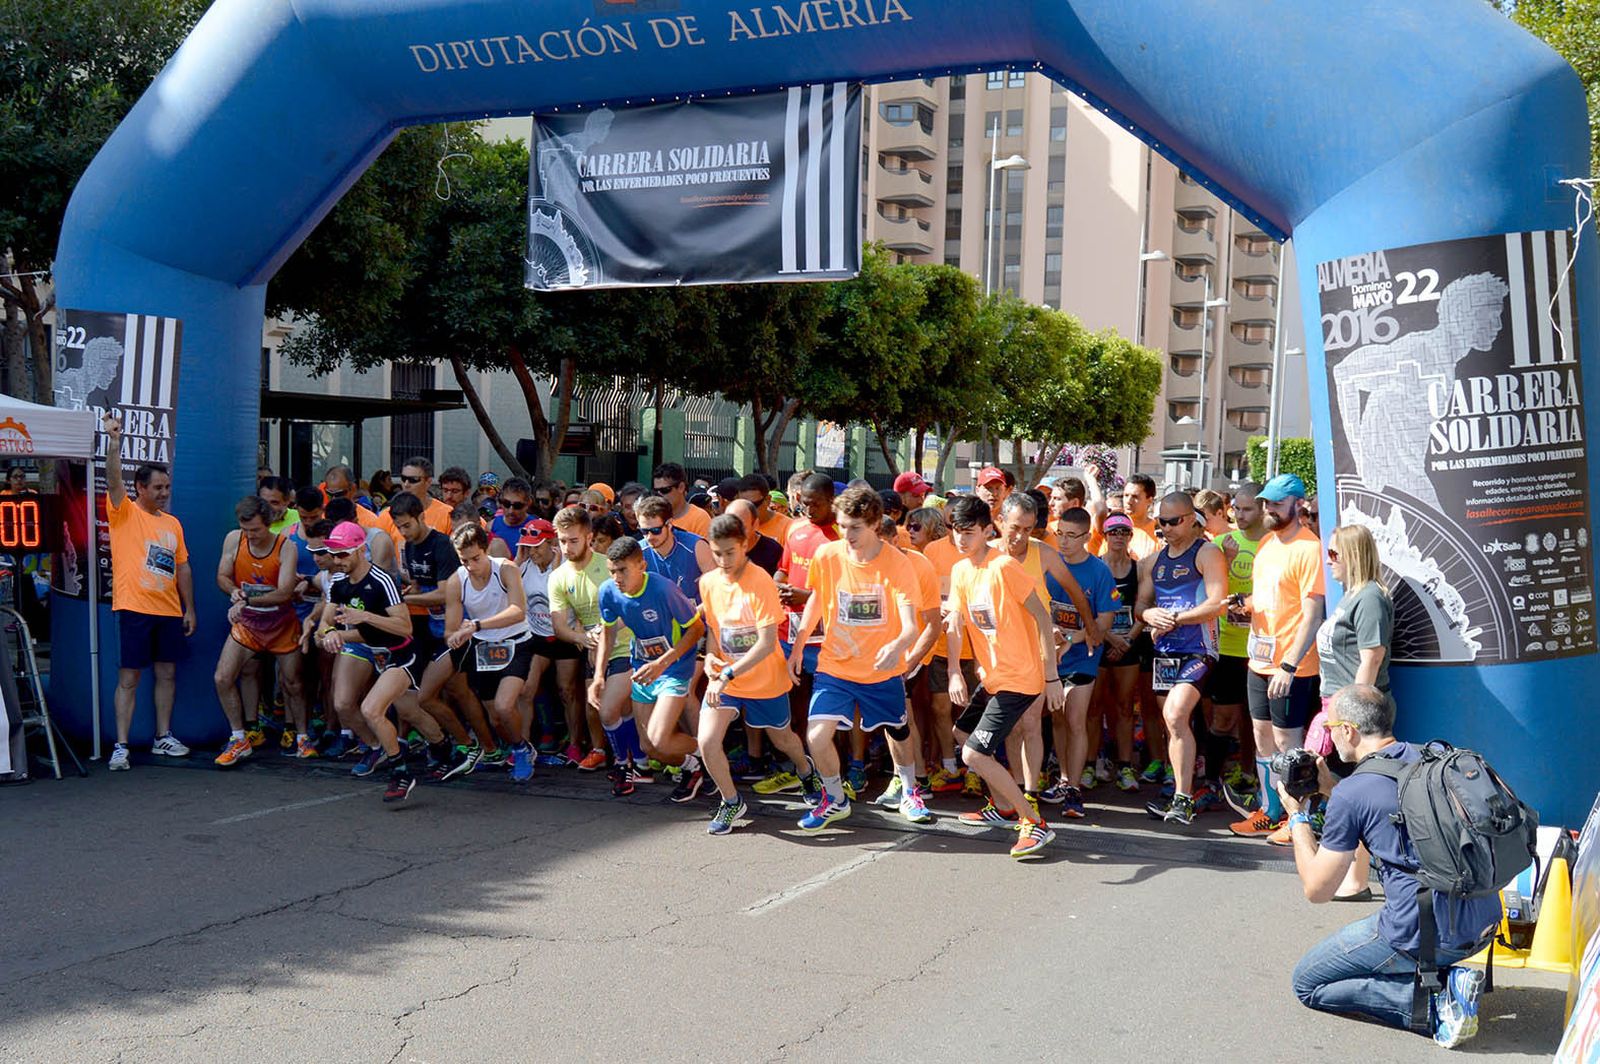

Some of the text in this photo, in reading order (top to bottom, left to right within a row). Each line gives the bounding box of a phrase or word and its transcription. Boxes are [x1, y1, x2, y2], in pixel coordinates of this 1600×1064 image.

[409, 18, 638, 73] DIPUTACIÓN
[648, 15, 706, 50] DE
[576, 140, 771, 178] CARRERA SOLIDARIA
[595, 178, 612, 191] LAS
[614, 173, 683, 190] ENFERMEDADES
[685, 171, 708, 185] POCO
[709, 168, 771, 184] FRECUENTES
[1351, 280, 1393, 295] Domingo
[1352, 268, 1442, 310] MAYO 22
[66, 326, 86, 350] 22
[1321, 302, 1400, 351] 2016
[1428, 369, 1581, 419] CARRERA
[1430, 409, 1583, 455] SOLIDARIA
[1431, 460, 1450, 471] POR
[1450, 458, 1465, 470] LAS
[1466, 453, 1527, 469] ENFERMEDADES
[1528, 451, 1546, 463] POCO
[1472, 478, 1506, 488] Recorrido
